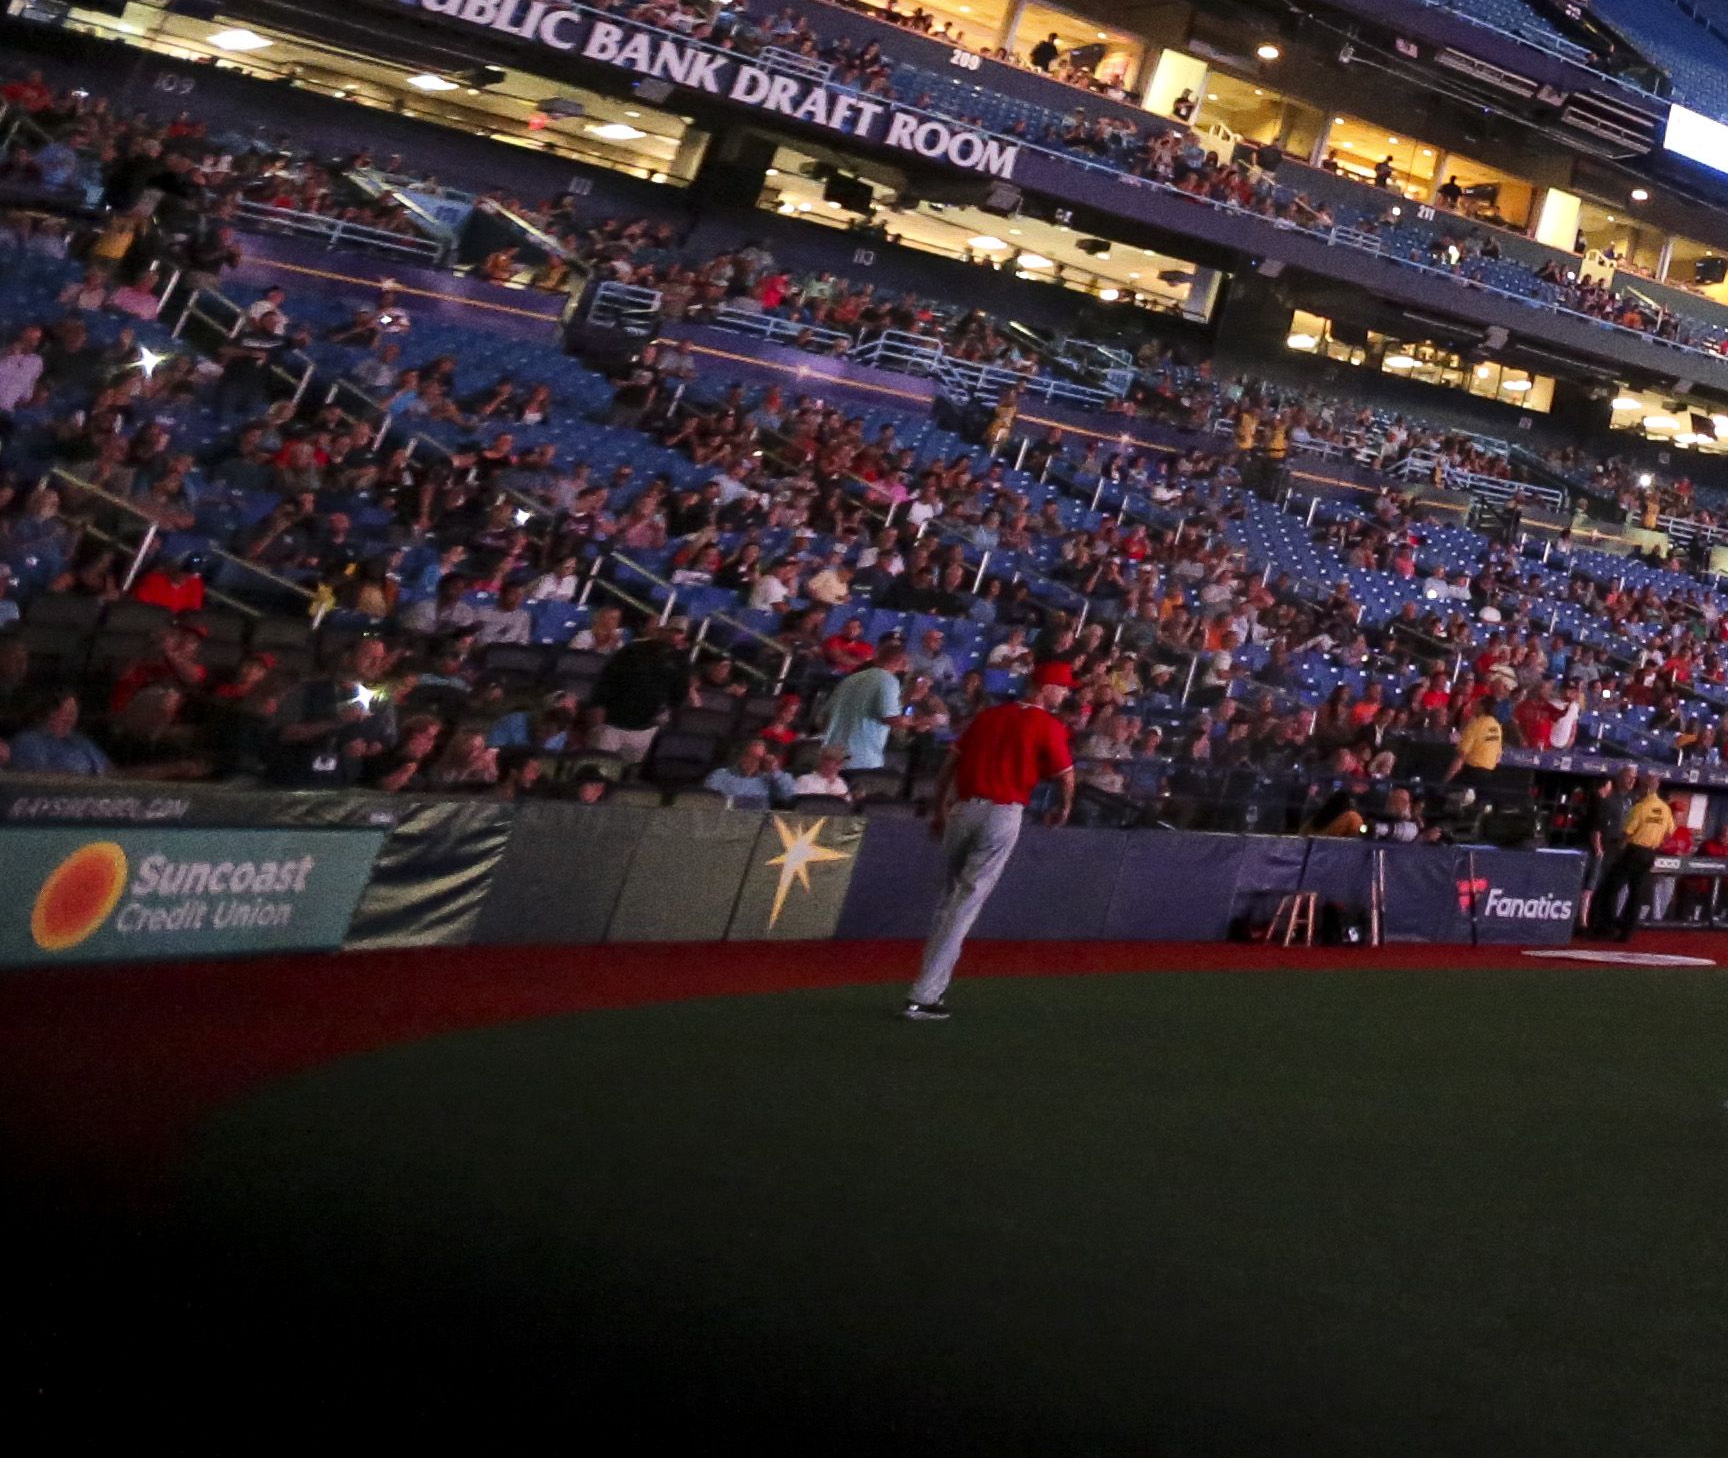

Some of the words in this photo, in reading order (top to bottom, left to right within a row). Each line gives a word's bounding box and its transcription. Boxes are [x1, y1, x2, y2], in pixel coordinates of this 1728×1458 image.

[949, 48, 982, 71] 209
[581, 20, 728, 93] BANK
[728, 63, 884, 137] DRAFT
[885, 111, 1020, 180] ROOM
[131, 852, 316, 896] Suncoast
[117, 901, 207, 933] Credit
[213, 898, 294, 929] Union
[1484, 888, 1572, 920] Fanatics
